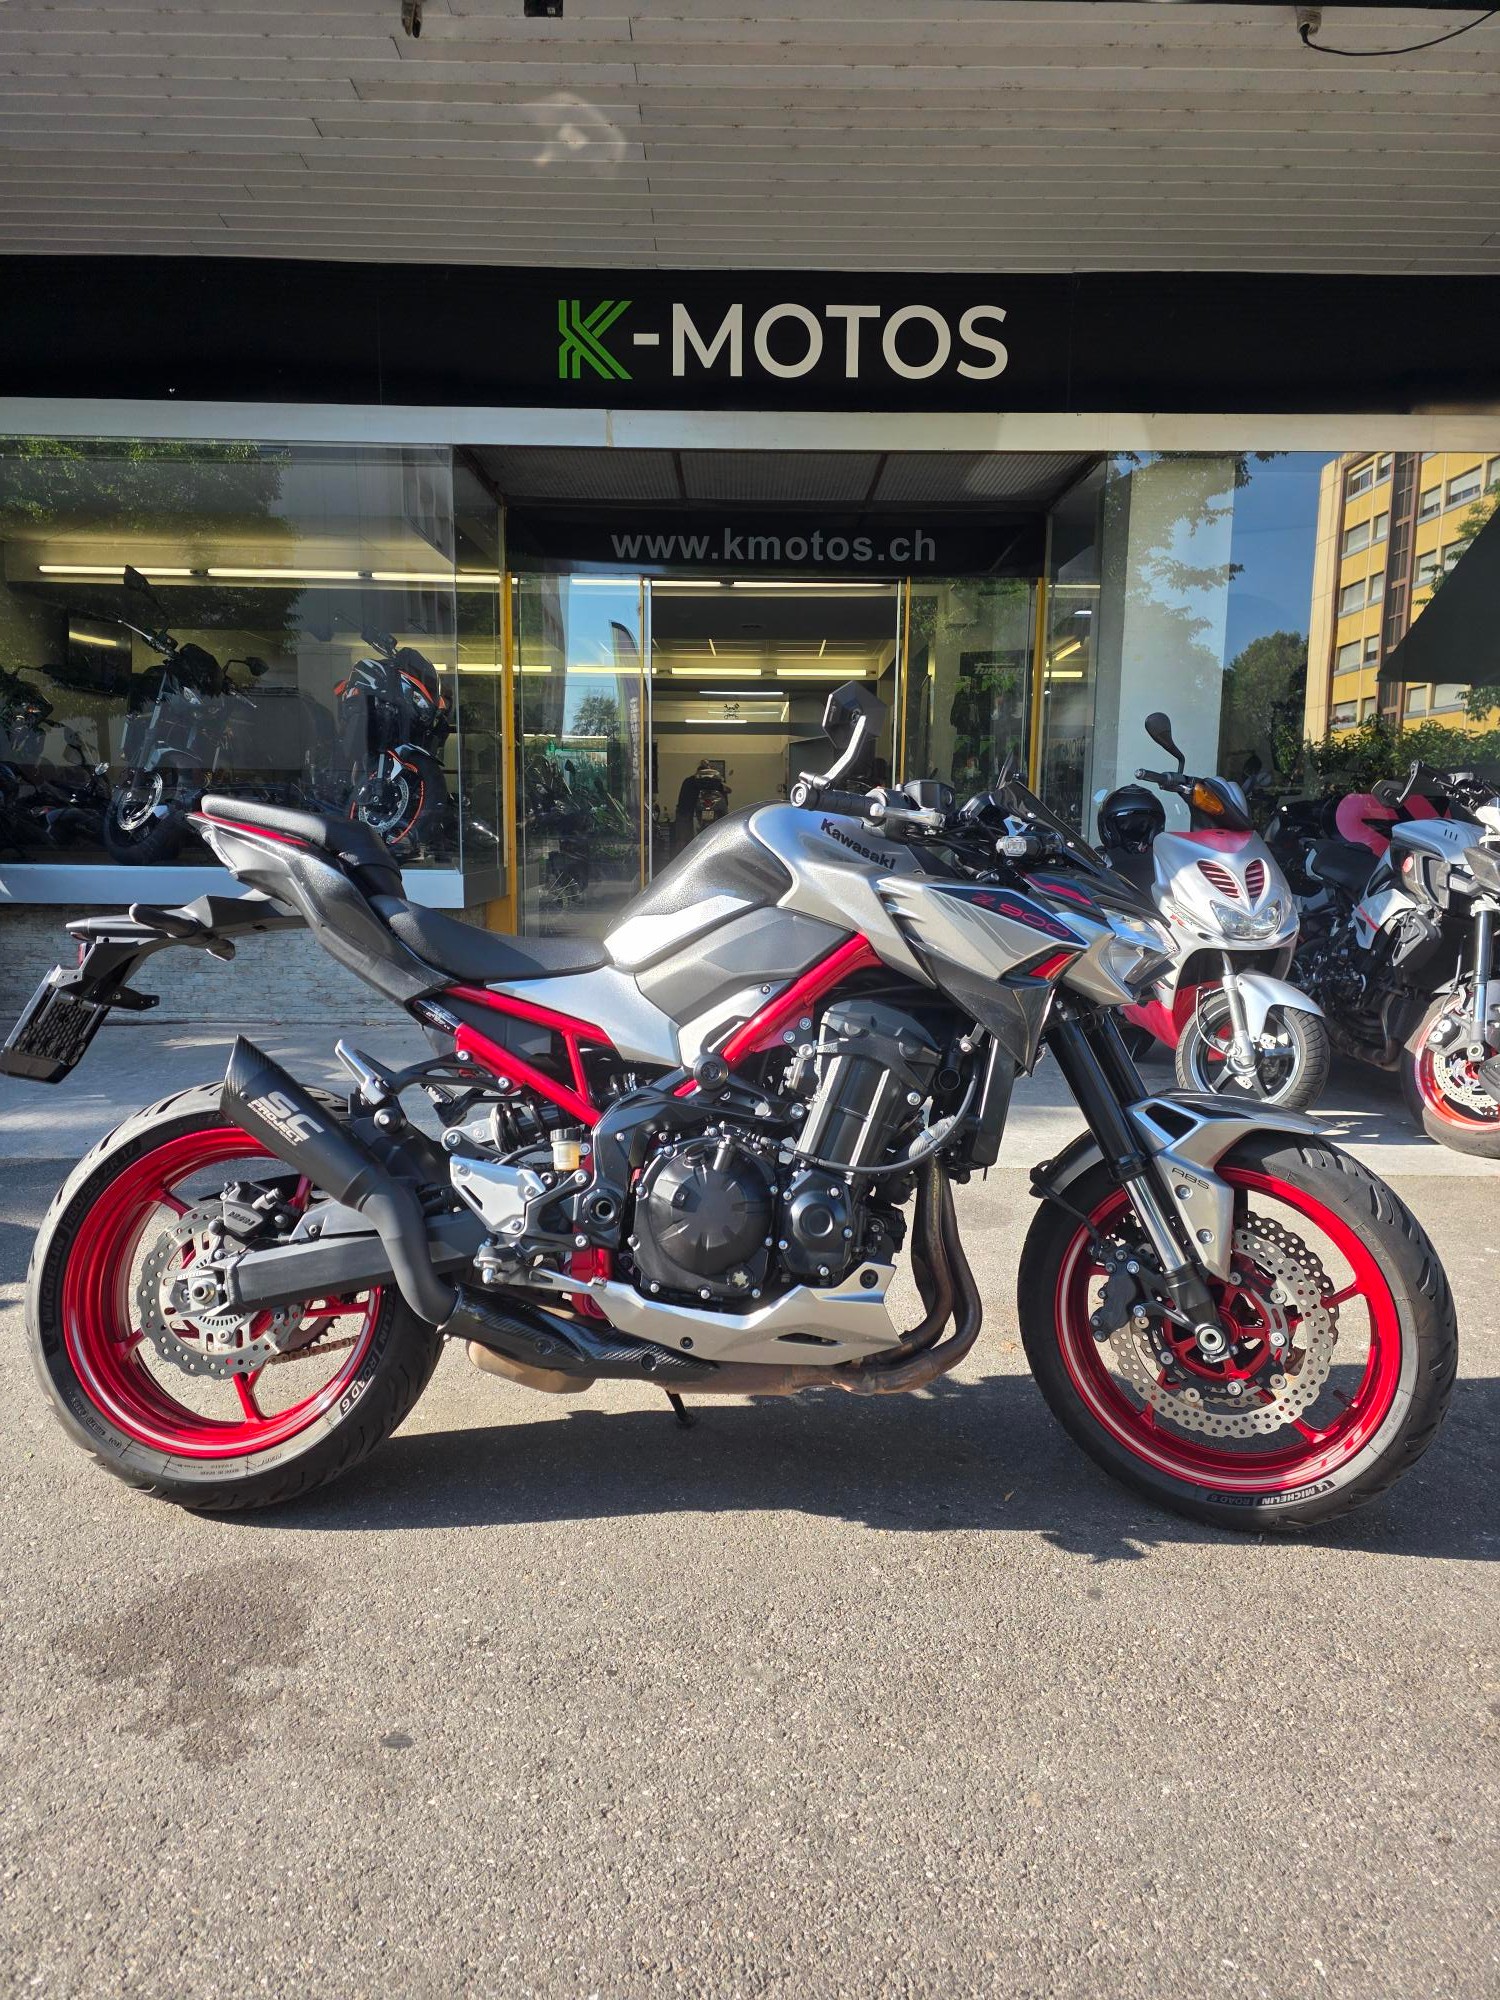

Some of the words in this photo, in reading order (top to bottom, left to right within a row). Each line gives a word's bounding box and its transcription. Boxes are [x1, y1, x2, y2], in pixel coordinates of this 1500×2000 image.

[558, 299, 1008, 380] K-MOTOS
[611, 528, 936, 561] www.kmotos.ch
[821, 818, 896, 870] Kawasaki
[250, 1099, 304, 1143] PROJECT
[1172, 1167, 1209, 1190] ABS
[42, 1240, 67, 1324] MICHELIN
[351, 1354, 379, 1400] ROAD
[1261, 1488, 1315, 1505] MICHELIN
